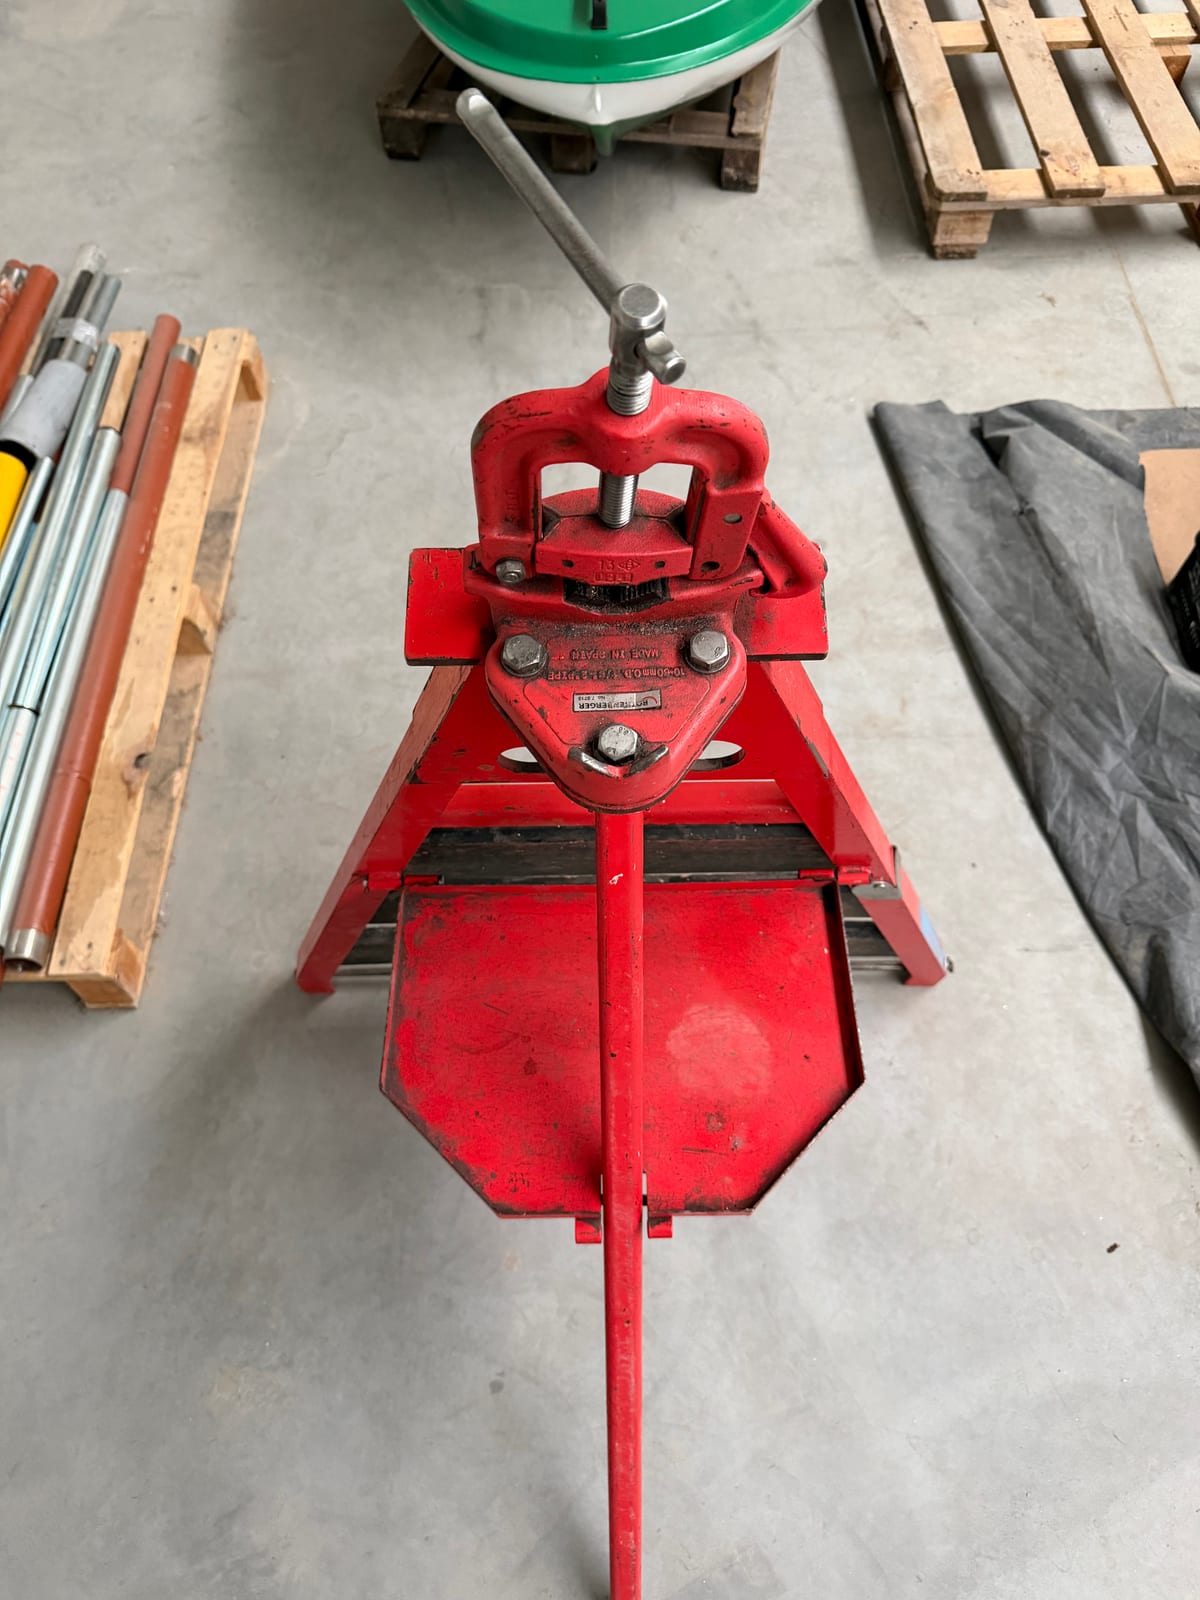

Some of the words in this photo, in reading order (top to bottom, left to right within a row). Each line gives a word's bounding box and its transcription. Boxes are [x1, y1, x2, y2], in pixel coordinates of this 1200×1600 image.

[571, 649, 606, 661] SPAIN
[611, 649, 625, 660] IN
[630, 648, 660, 660] MADE
